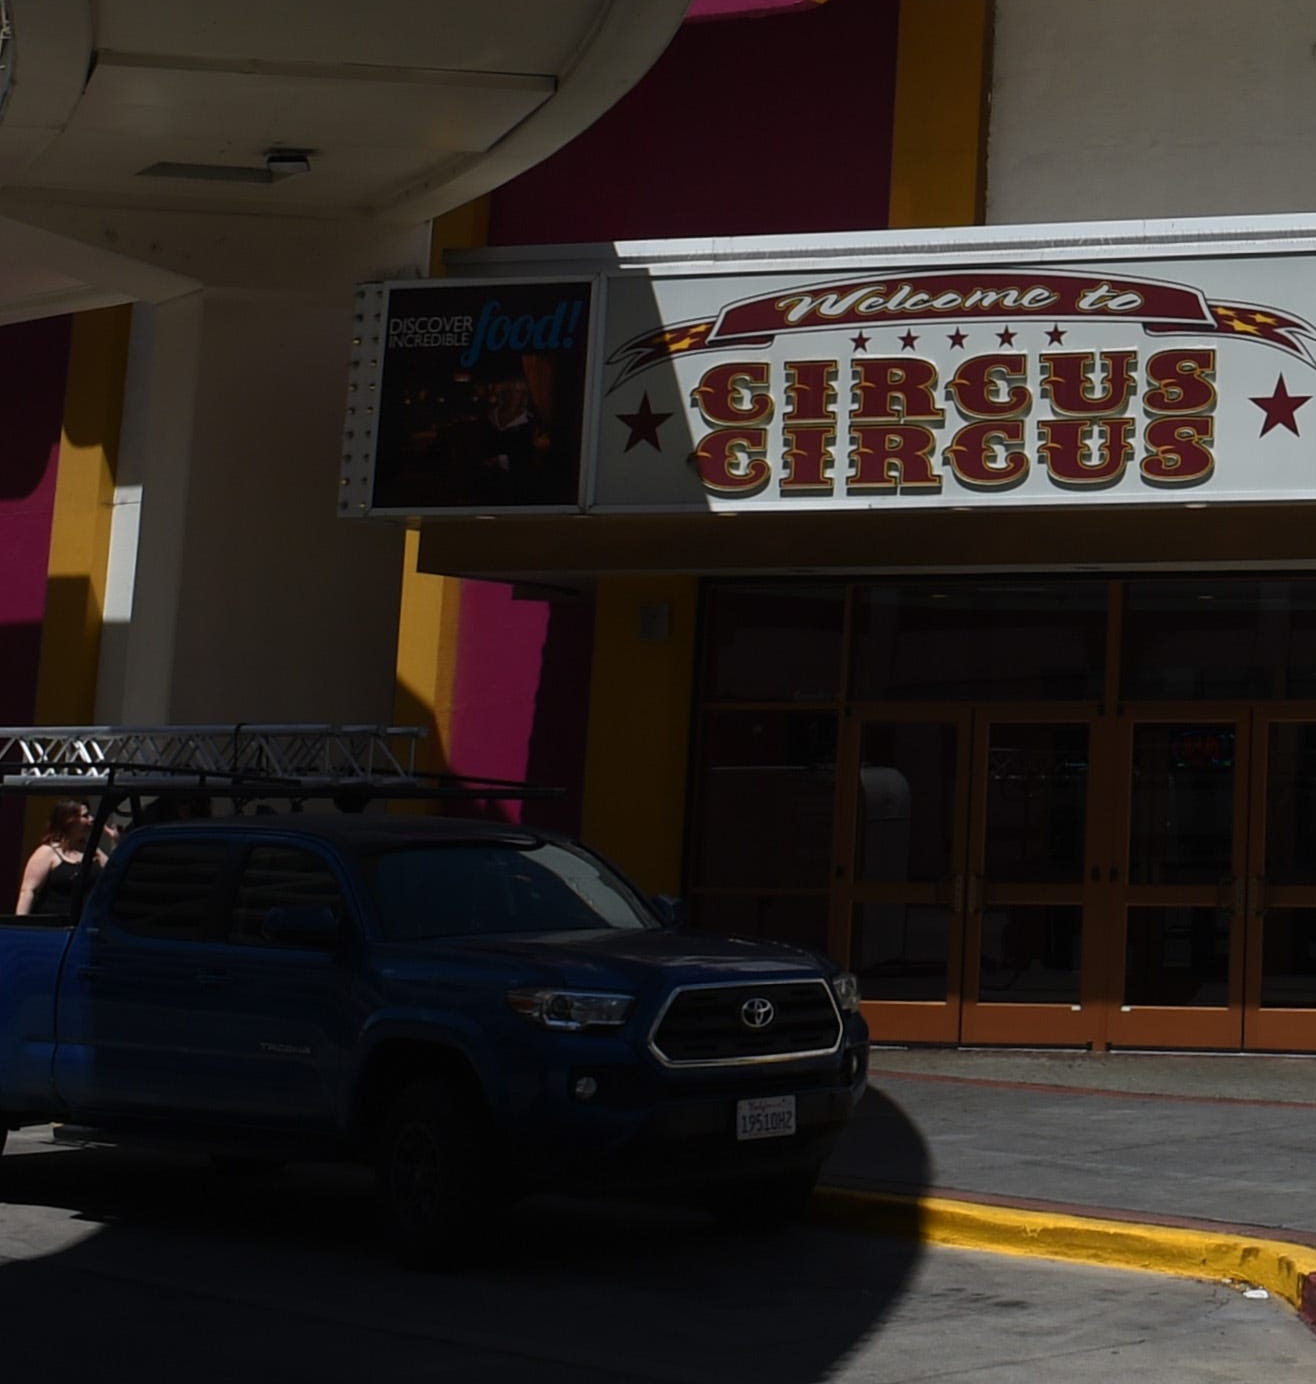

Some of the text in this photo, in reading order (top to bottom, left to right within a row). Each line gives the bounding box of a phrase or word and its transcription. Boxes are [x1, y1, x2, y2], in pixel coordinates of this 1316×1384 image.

[389, 316, 473, 334] DISCOVER
[778, 280, 1143, 322] Welcome to
[388, 333, 470, 349] INCREDIBLE
[459, 298, 585, 368] food!
[691, 347, 1216, 425] CIRCUS
[687, 416, 1214, 496] CIRCUS
